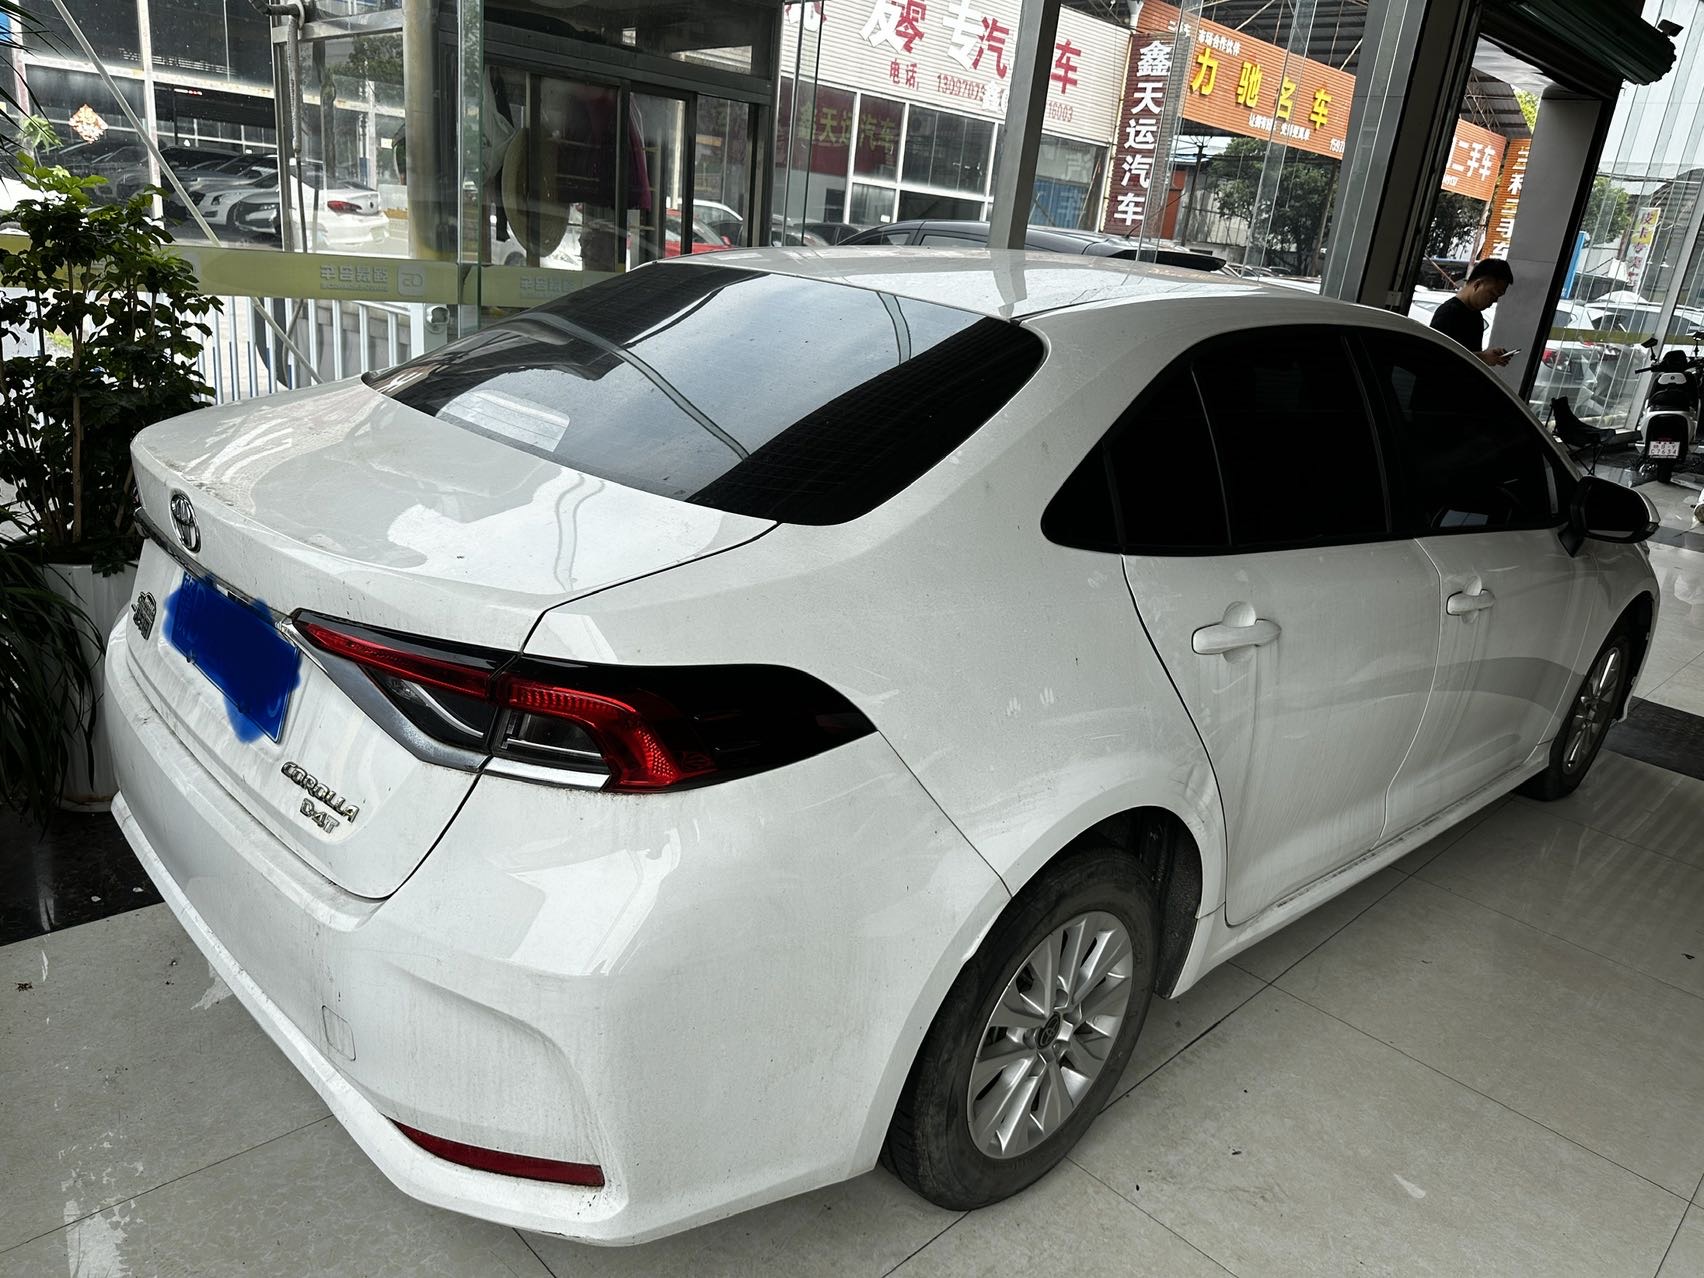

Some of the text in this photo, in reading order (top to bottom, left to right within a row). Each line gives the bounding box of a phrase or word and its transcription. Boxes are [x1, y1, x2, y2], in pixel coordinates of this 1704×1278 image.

[1189, 47, 1333, 130] 力驰名车
[1114, 41, 1172, 226] 鑫天运汽车
[281, 761, 360, 824] COROLLA
